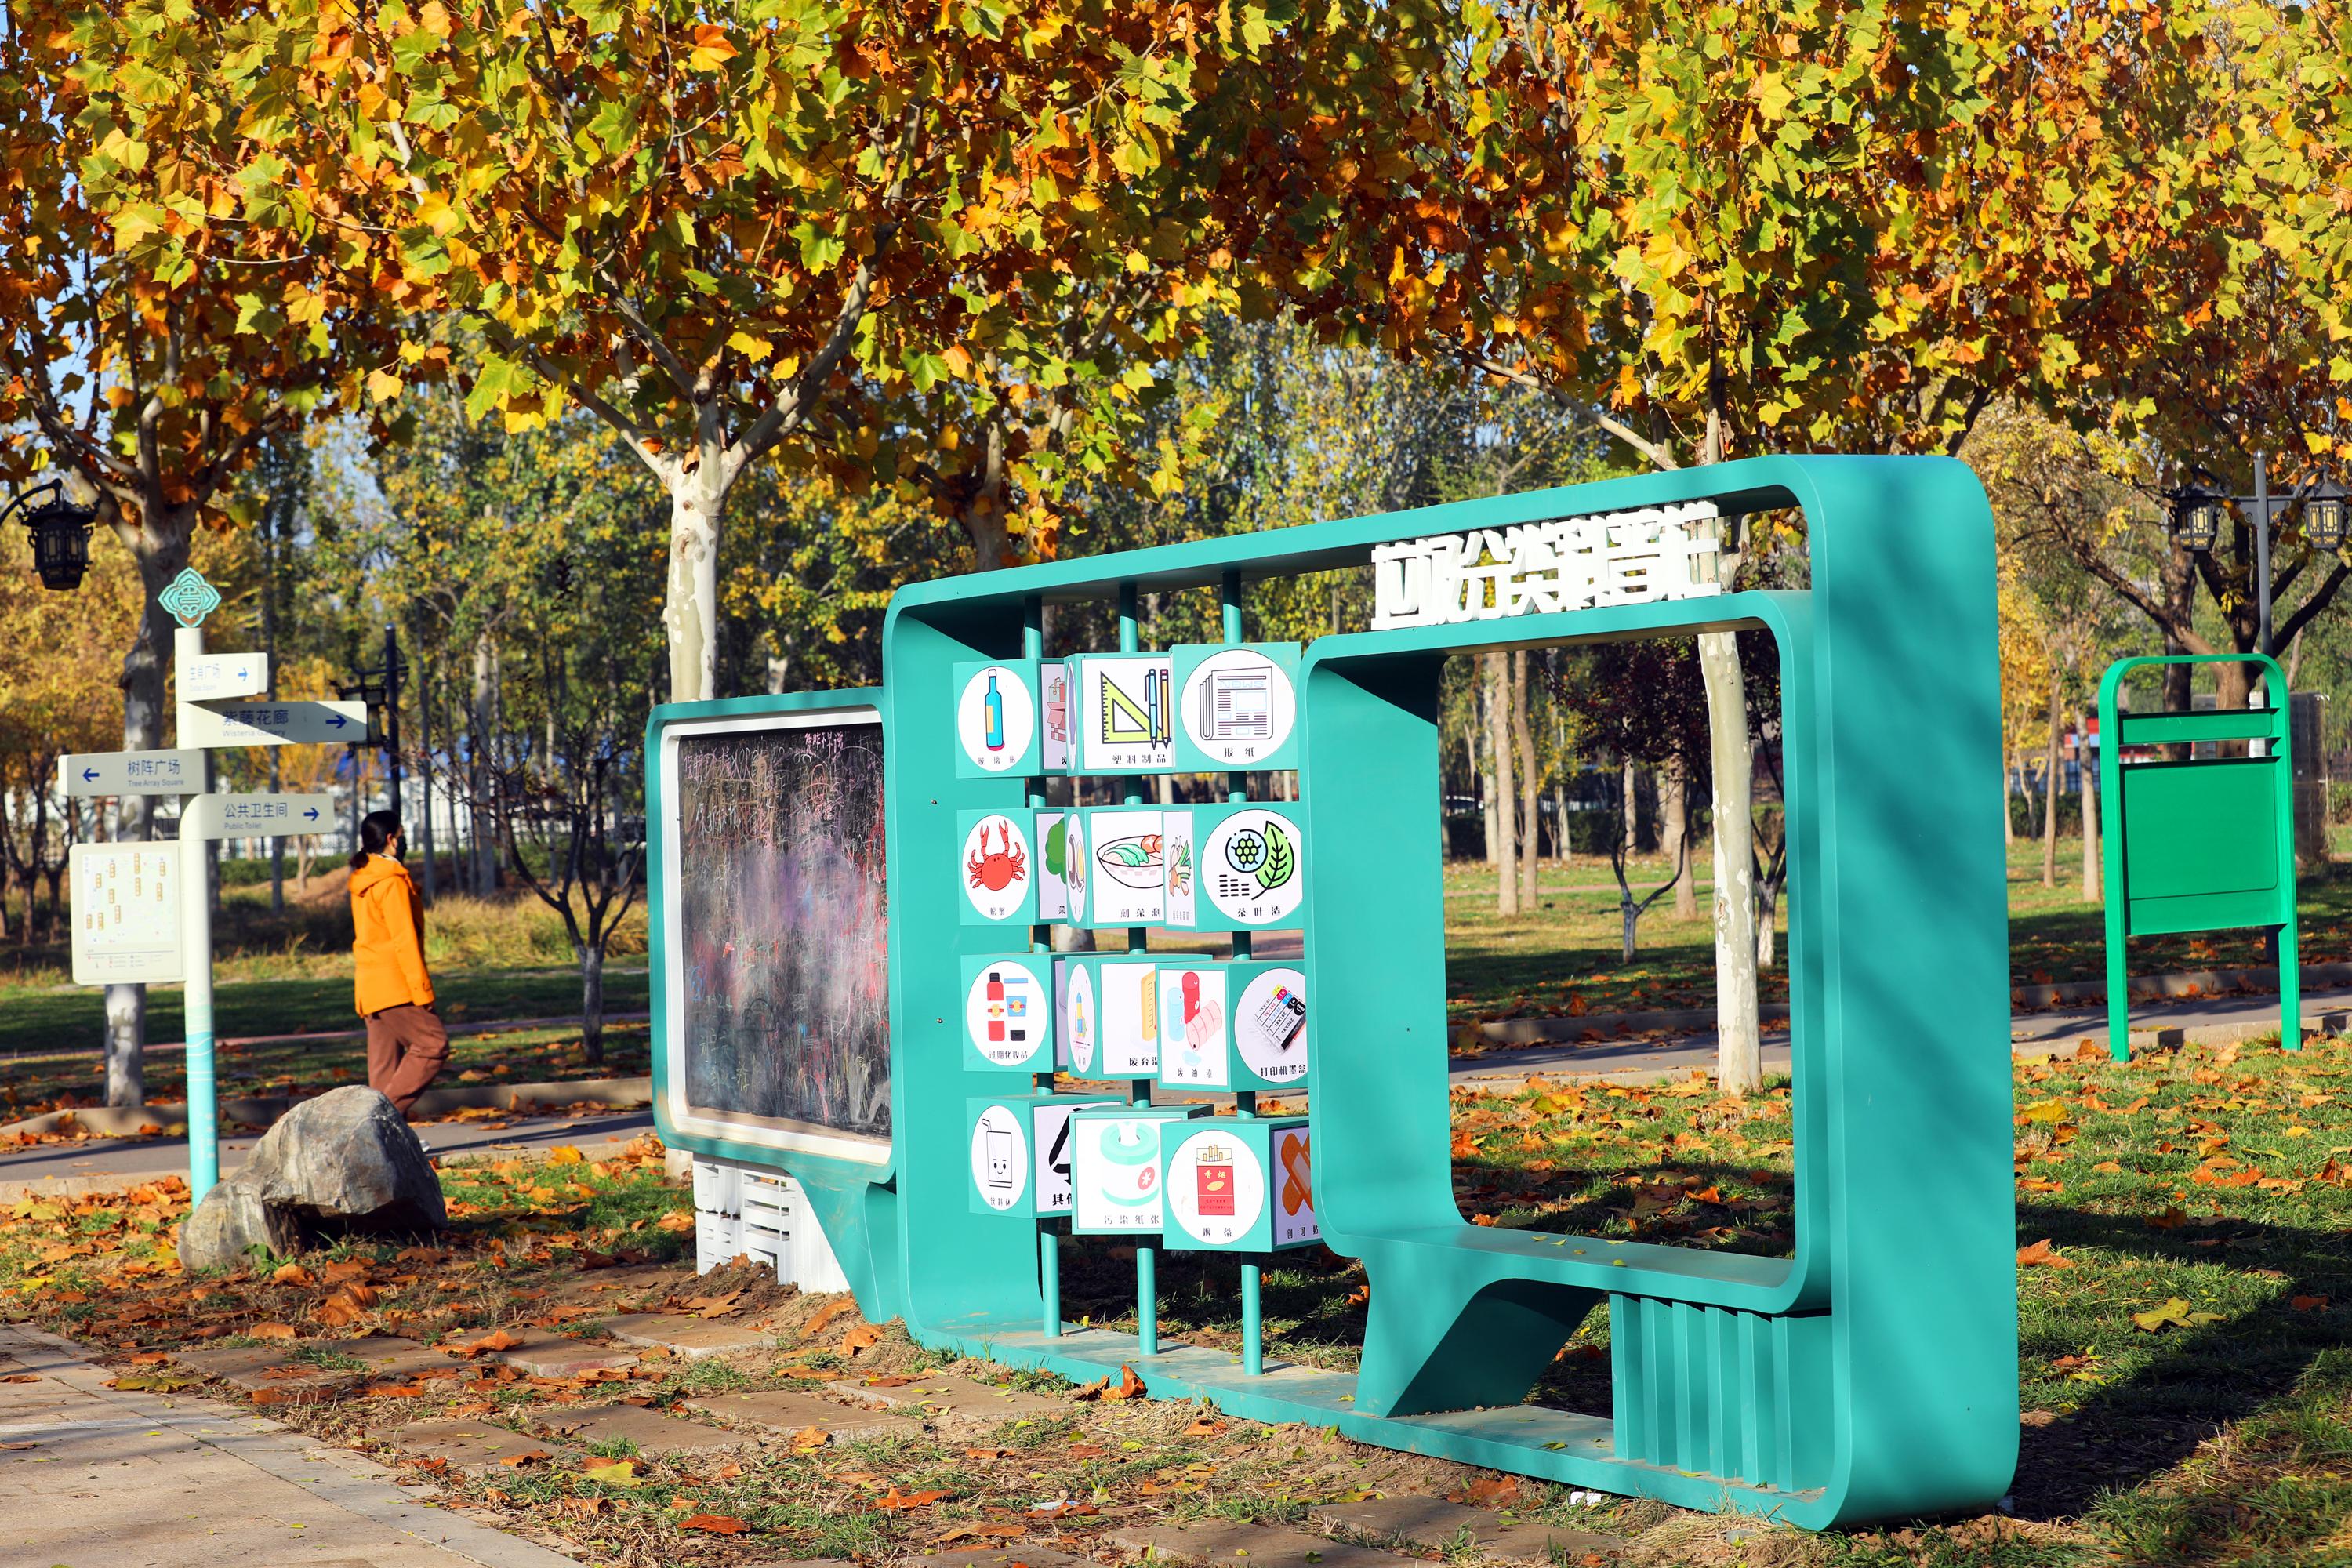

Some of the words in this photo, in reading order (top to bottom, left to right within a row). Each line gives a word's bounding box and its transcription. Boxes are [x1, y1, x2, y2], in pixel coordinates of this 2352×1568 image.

[223, 709, 289, 726] 紫藤花廊
[1224, 747, 1255, 757] 报纸
[1112, 753, 1166, 764] 塑料制品
[128, 759, 180, 776] 树阵广场
[224, 802, 288, 818] 公共卫生间
[1238, 906, 1280, 917] 茶叶渣
[989, 1051, 1028, 1059] 过期化妆品
[1178, 1067, 1212, 1078] 废油漆
[1261, 1065, 1306, 1077] 打印机墨盒
[1204, 1169, 1226, 1179] 香烟
[1104, 1215, 1160, 1225] 污染纸张
[1287, 1224, 1319, 1239] 创可贴
